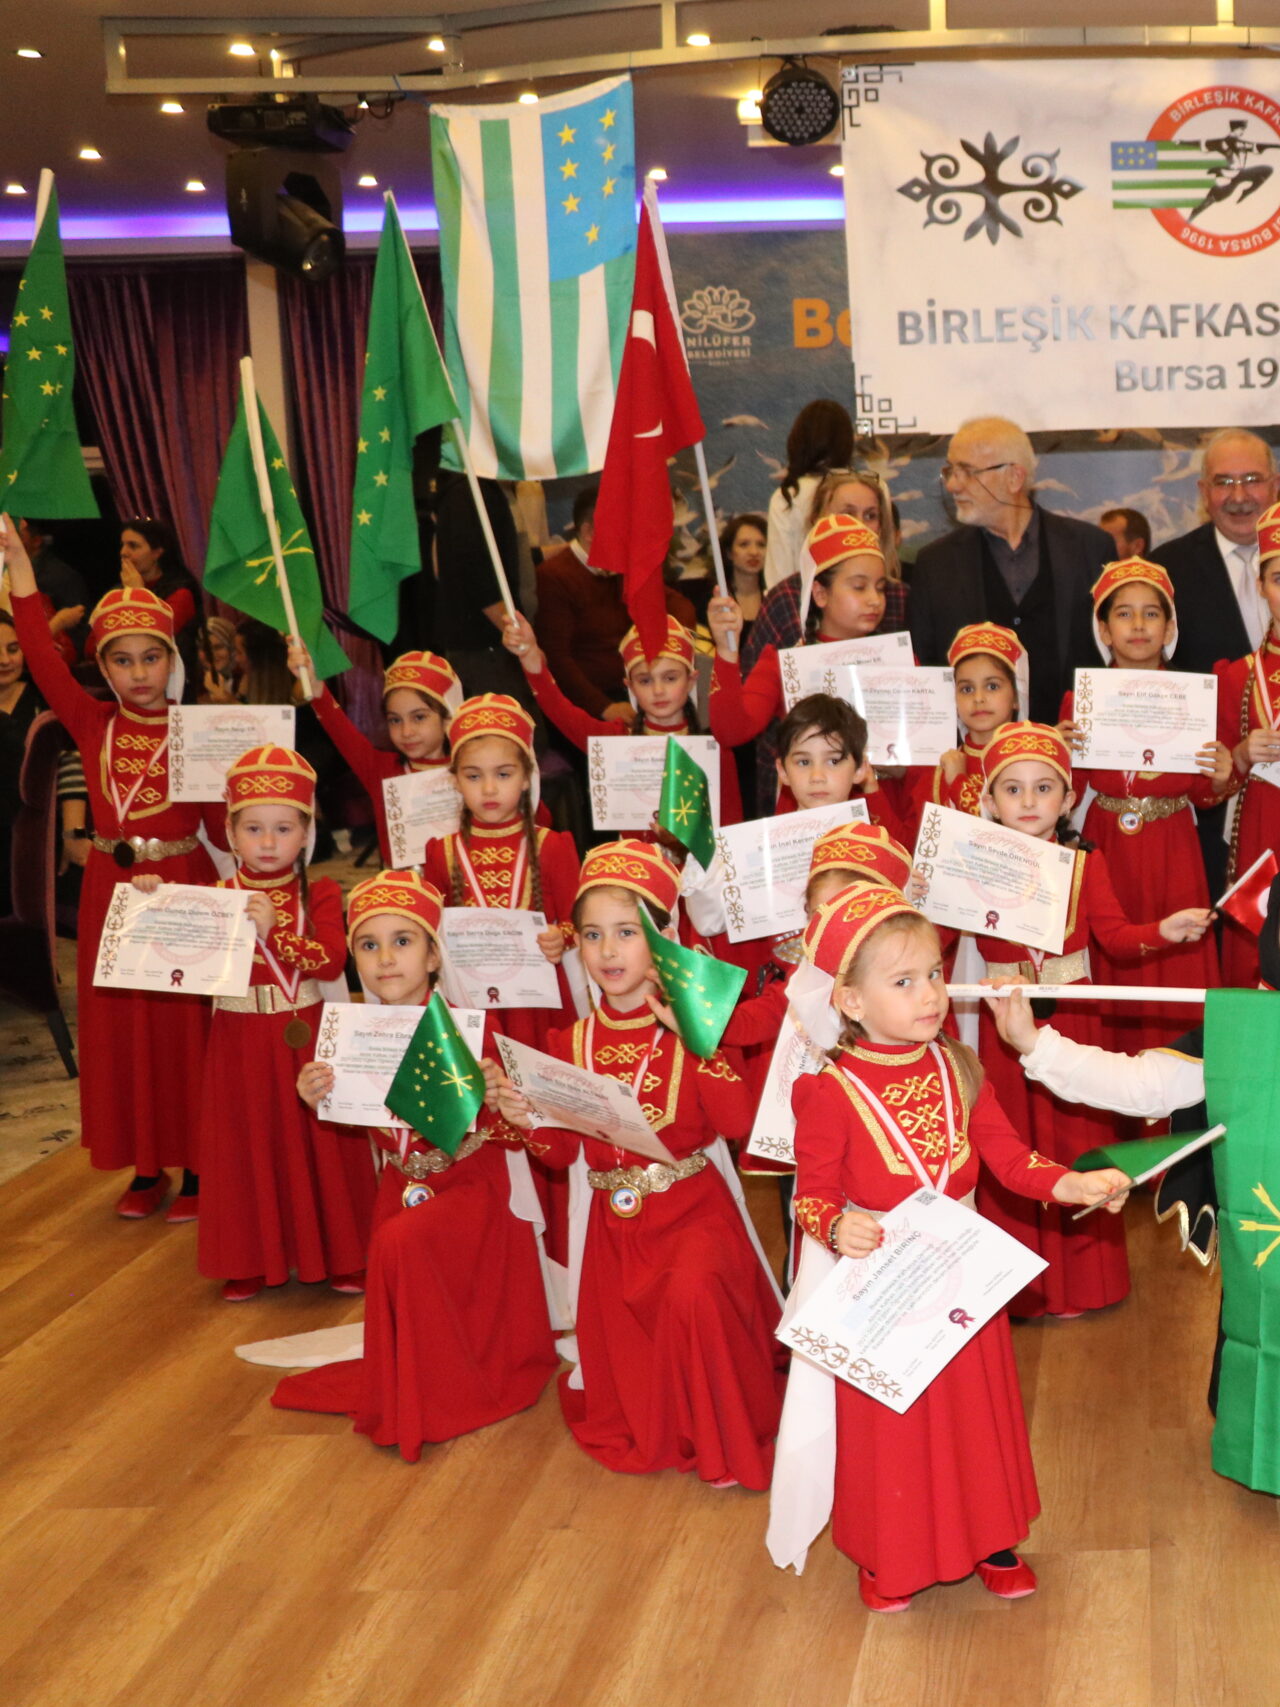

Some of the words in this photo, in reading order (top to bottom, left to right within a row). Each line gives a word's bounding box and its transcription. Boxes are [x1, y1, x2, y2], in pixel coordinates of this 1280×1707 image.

[1169, 89, 1241, 123] BİRLEŞİK
[1181, 226, 1214, 250] 1996
[1219, 229, 1273, 253] BURSA
[897, 297, 1097, 353] BİRLEŞİK
[1115, 360, 1228, 393] Bursa
